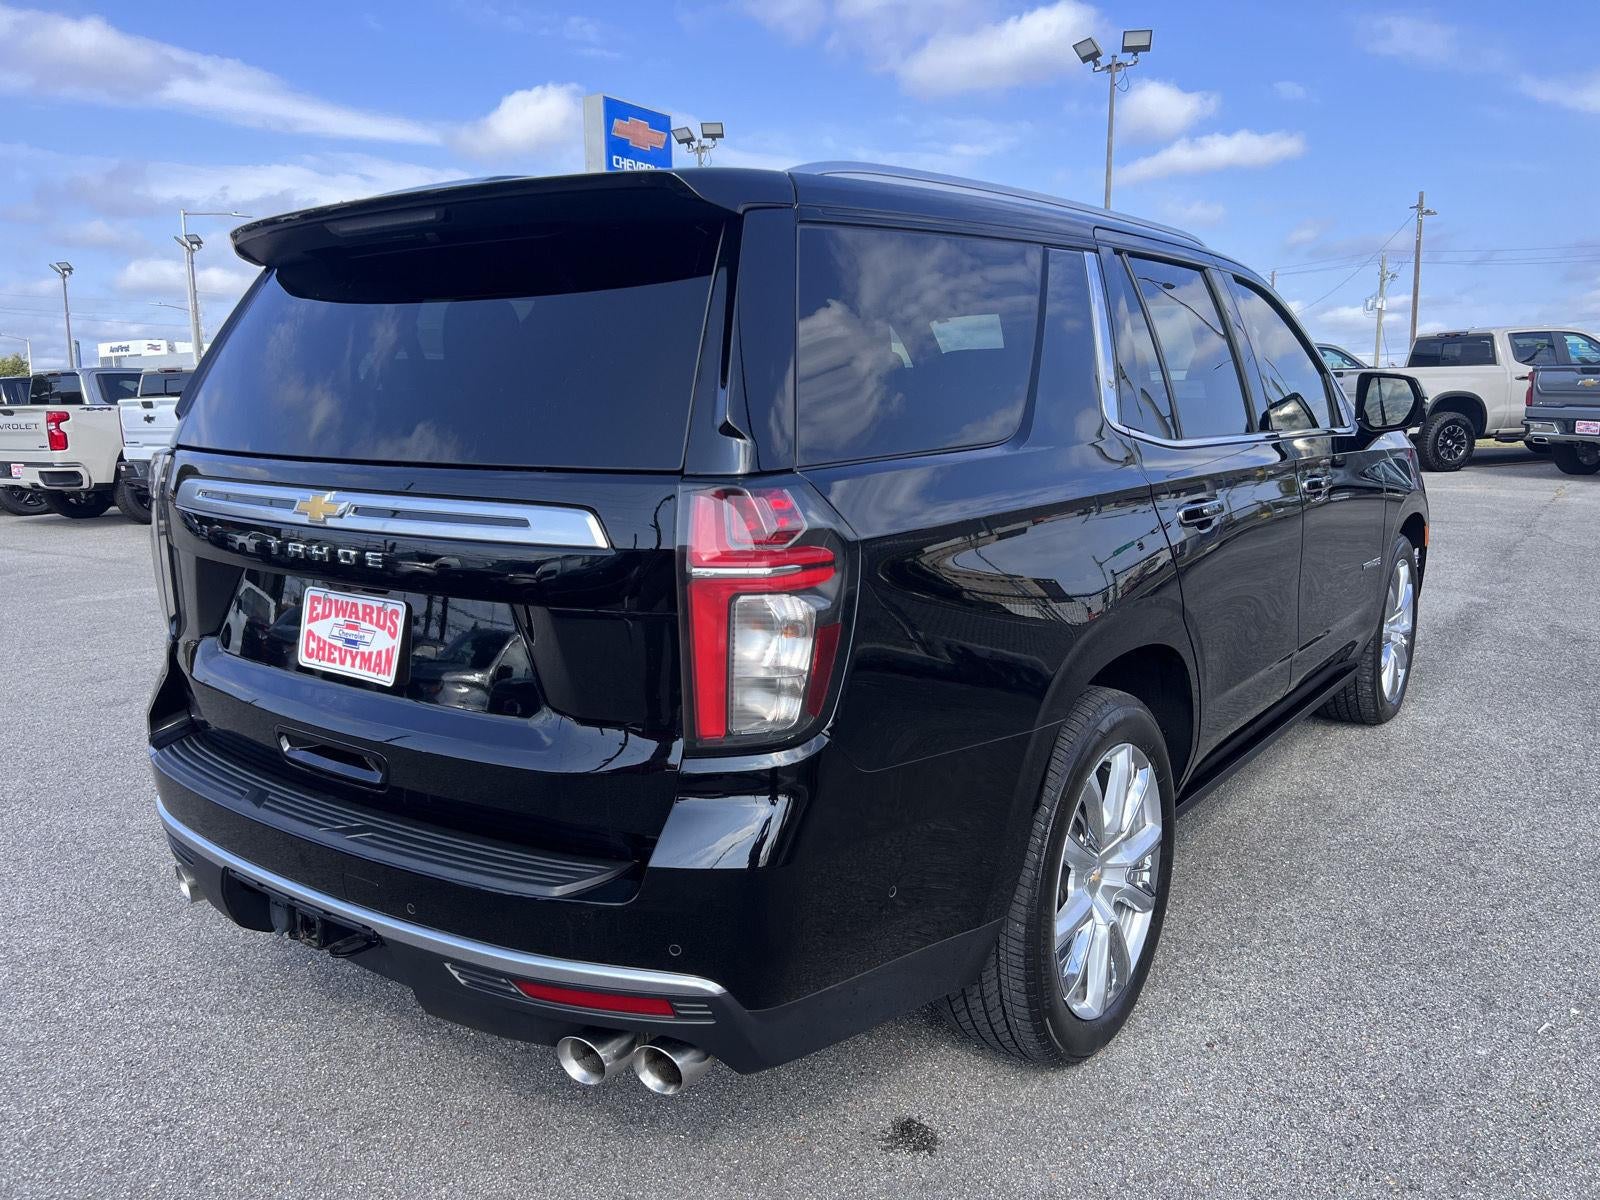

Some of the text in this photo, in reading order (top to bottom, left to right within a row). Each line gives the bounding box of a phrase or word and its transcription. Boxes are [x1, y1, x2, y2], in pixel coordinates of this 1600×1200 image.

[612, 155, 656, 171] CHEVRO
[266, 539, 383, 569] TAHOE
[307, 595, 400, 640] EDWARDS
[338, 629, 366, 641] Chevrolet
[304, 629, 396, 677] CHEVYMAN
